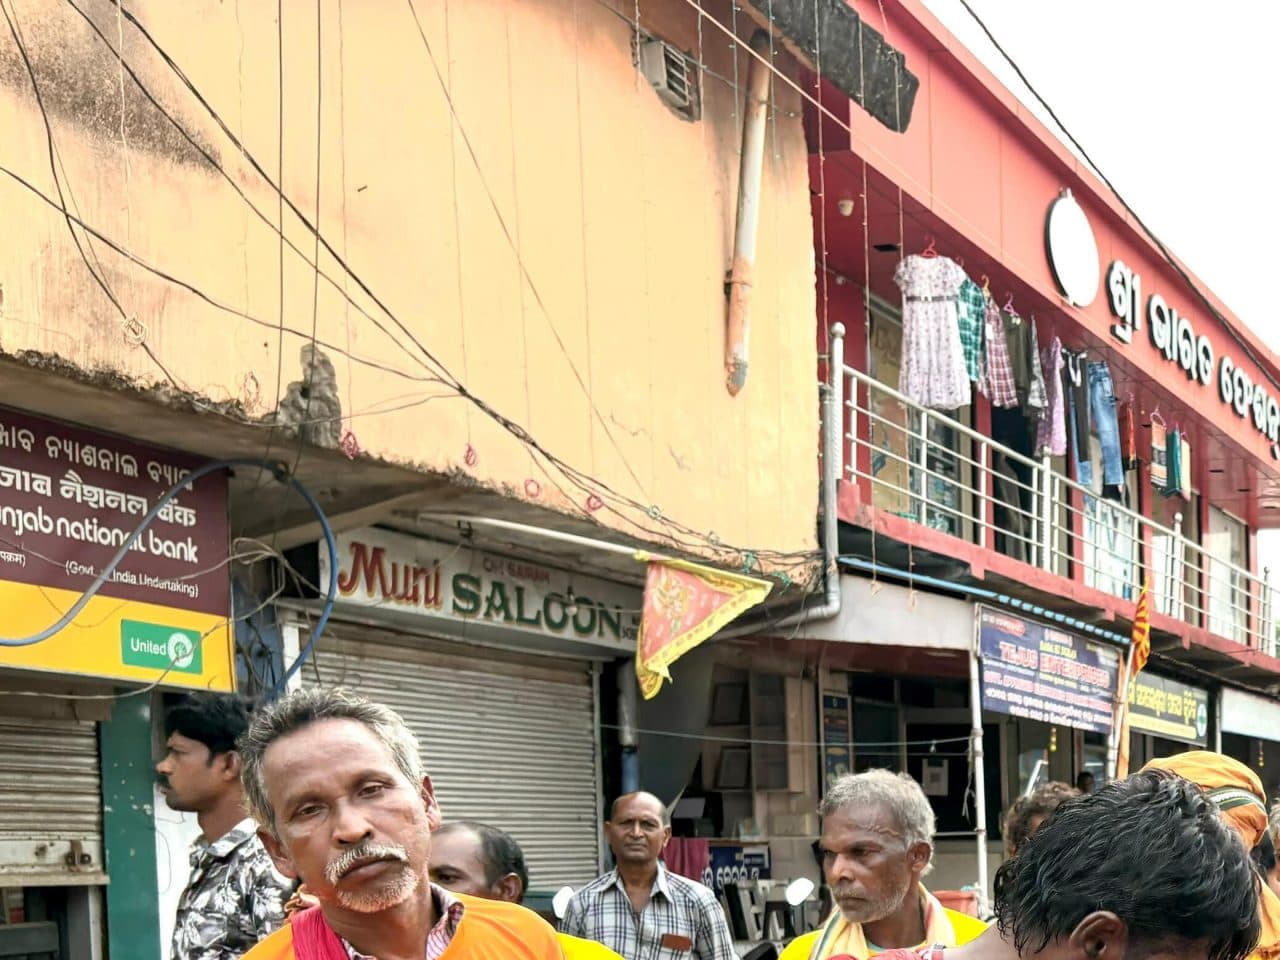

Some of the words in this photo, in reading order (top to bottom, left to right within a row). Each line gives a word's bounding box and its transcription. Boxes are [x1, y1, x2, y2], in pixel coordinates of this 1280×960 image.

[1107, 260, 1141, 344] ଶ୍ରୀ
[60, 469, 148, 517] नैशनल
[0, 501, 53, 536] njab
[149, 529, 198, 563] bank
[452, 573, 622, 641] SALOON
[130, 637, 167, 656] United
